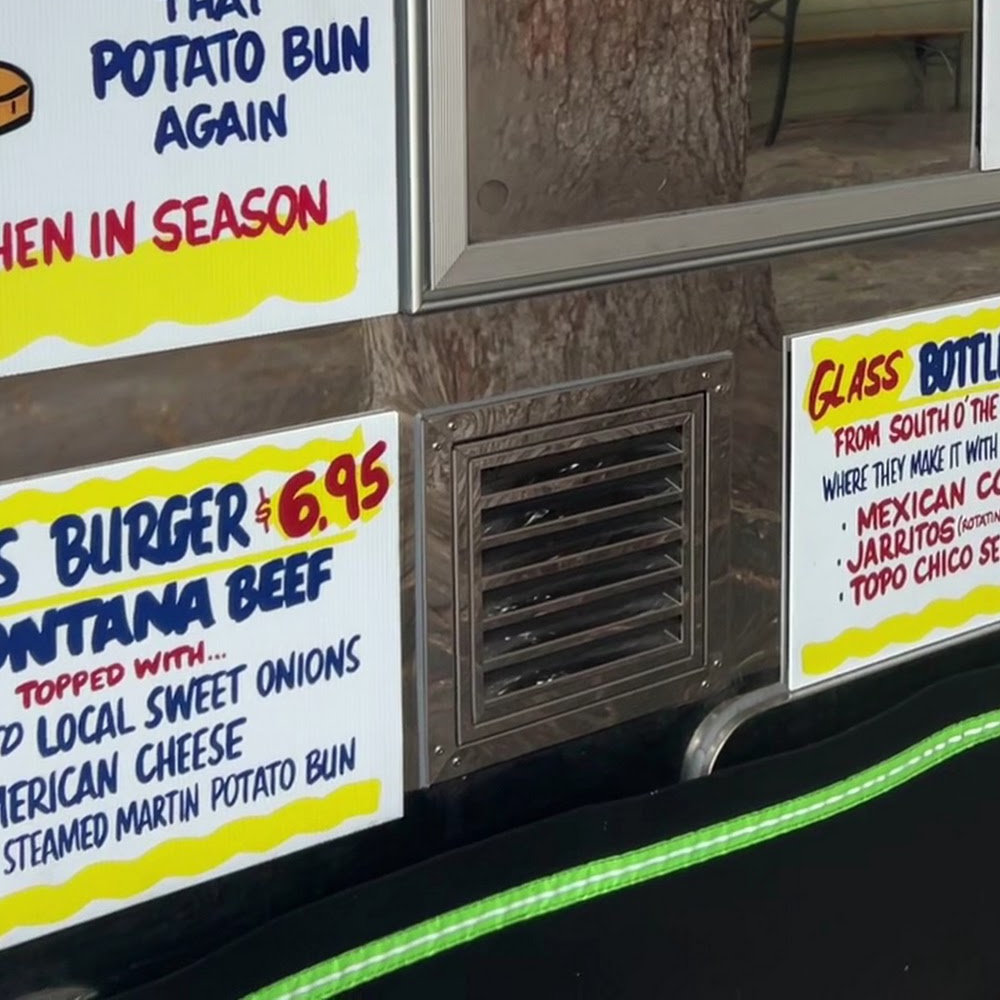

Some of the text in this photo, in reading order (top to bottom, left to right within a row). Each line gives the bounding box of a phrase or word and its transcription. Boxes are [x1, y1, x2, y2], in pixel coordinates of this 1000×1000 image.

[90, 16, 370, 100] POTATO BUN
[154, 93, 288, 155] AGAIN
[90, 200, 136, 259] IN
[152, 179, 328, 252] SEASON
[809, 350, 904, 421] GLASS
[834, 420, 880, 457] FROM
[889, 403, 949, 444] SOUTH
[970, 393, 999, 425] THE
[823, 463, 869, 501] WHERE
[872, 454, 907, 488] THEY
[910, 445, 945, 479] MAKE
[949, 442, 960, 470] IT
[965, 431, 998, 465] WITH
[50, 482, 251, 587] BURGER
[255, 440, 390, 538] $6.95
[857, 477, 966, 536] MEXICAN
[847, 516, 955, 574] JARRITOS
[850, 564, 907, 606] TOPO
[914, 544, 973, 584] CHICO
[225, 547, 333, 623] BEEF
[15, 662, 125, 709] TOPPED
[36, 698, 136, 758] LOCAL
[144, 664, 248, 730] SWEET
[256, 634, 361, 698] ONIONS
[135, 717, 247, 783] CHEESE
[3, 737, 356, 875] STEAMED MARTIN POTATO BUN
